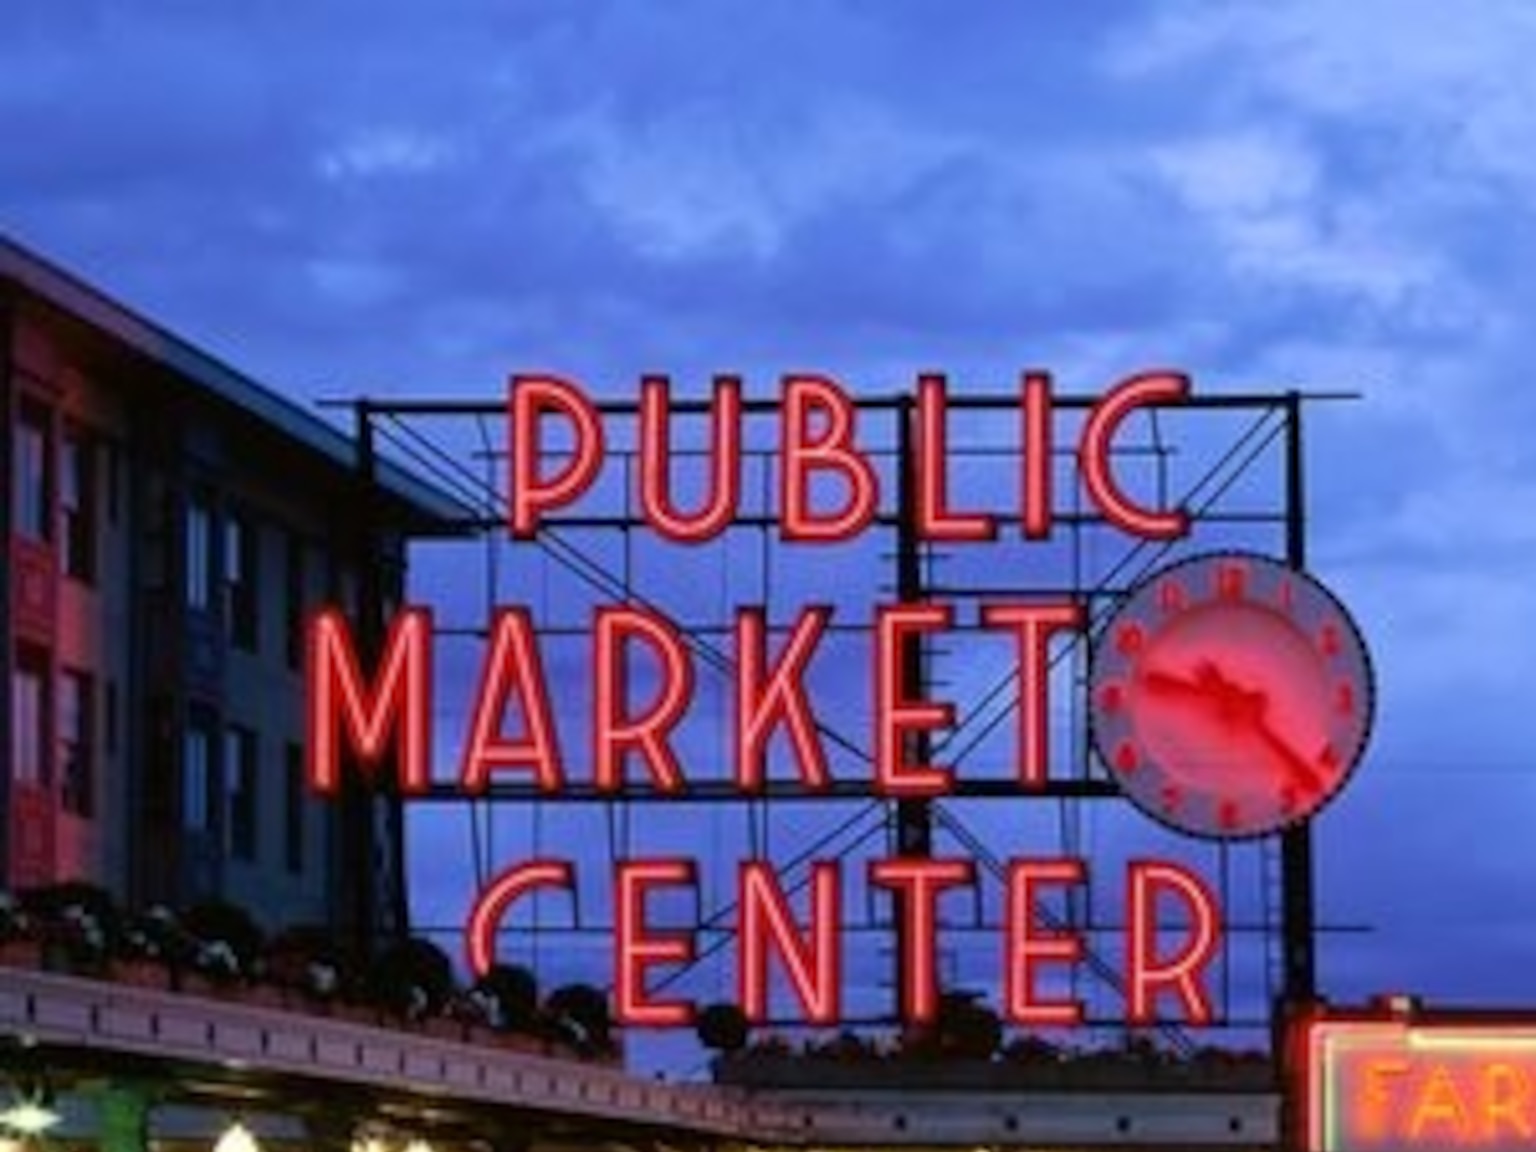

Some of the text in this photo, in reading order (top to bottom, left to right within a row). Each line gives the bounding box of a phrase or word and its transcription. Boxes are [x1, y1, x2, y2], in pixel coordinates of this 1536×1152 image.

[508, 372, 1191, 541] PUBLIC
[307, 602, 1087, 794] MARKET
[466, 857, 1222, 1027] CENTER
